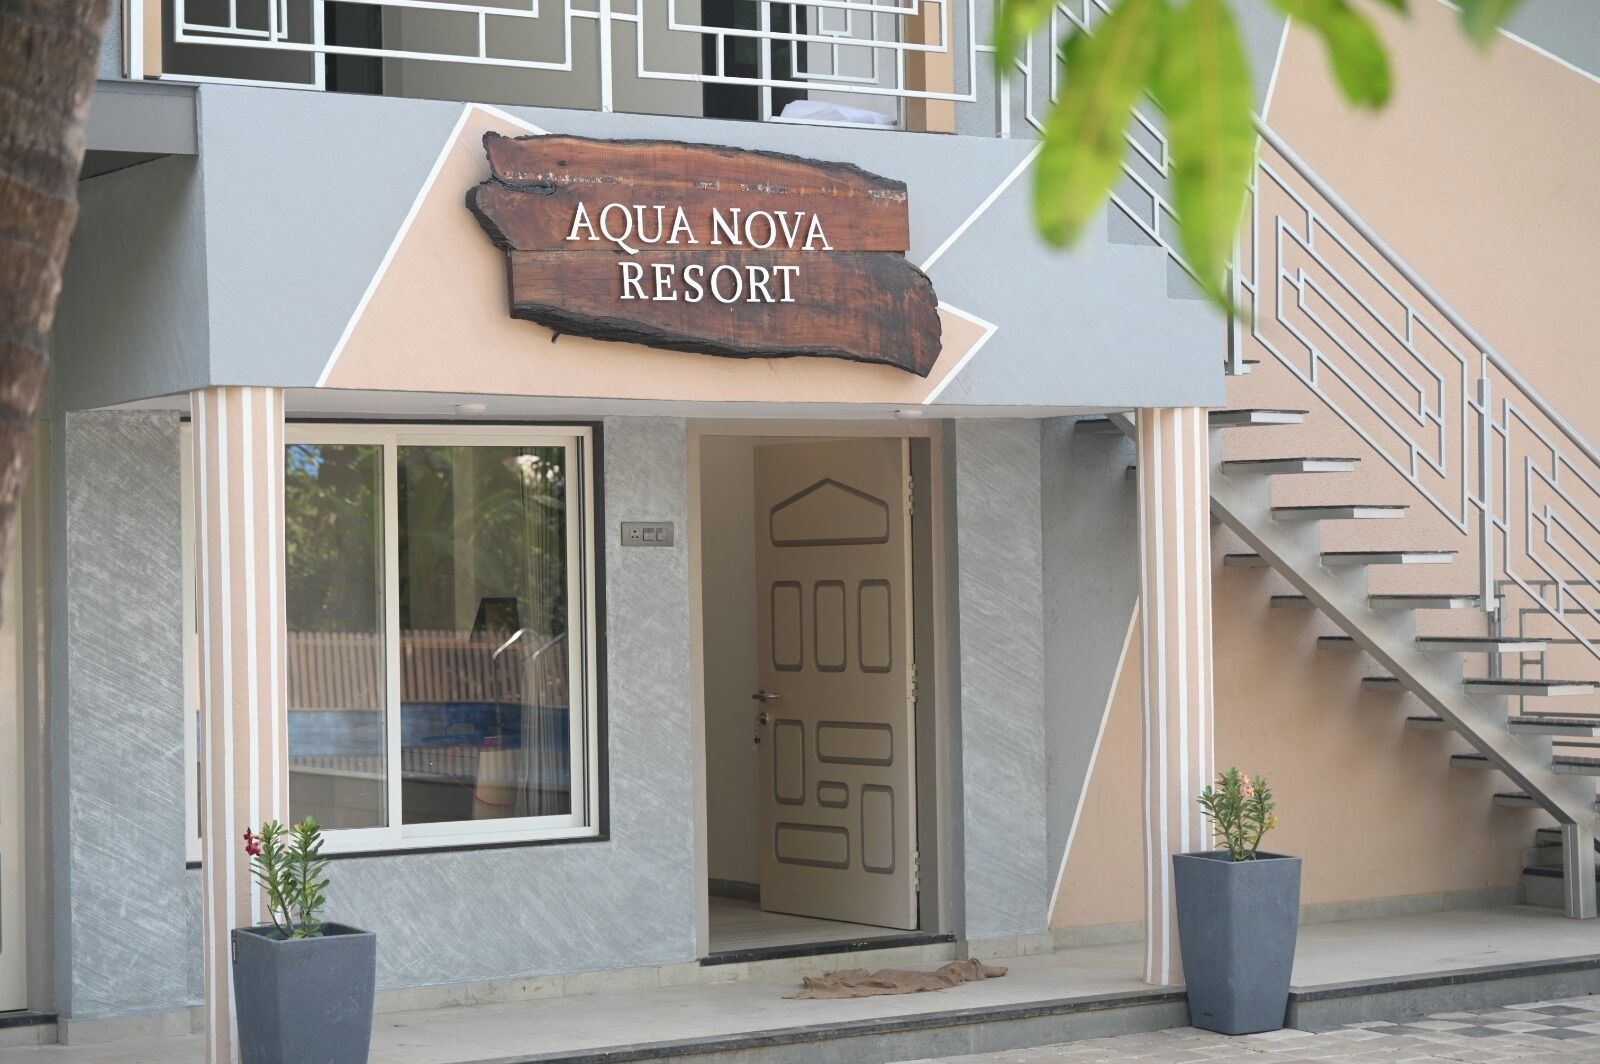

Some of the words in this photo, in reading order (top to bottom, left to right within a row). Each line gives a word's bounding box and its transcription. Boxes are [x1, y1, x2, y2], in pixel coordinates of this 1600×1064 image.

[566, 201, 699, 255] AQUA
[710, 207, 834, 251] NOVA
[618, 261, 800, 304] RESORT
